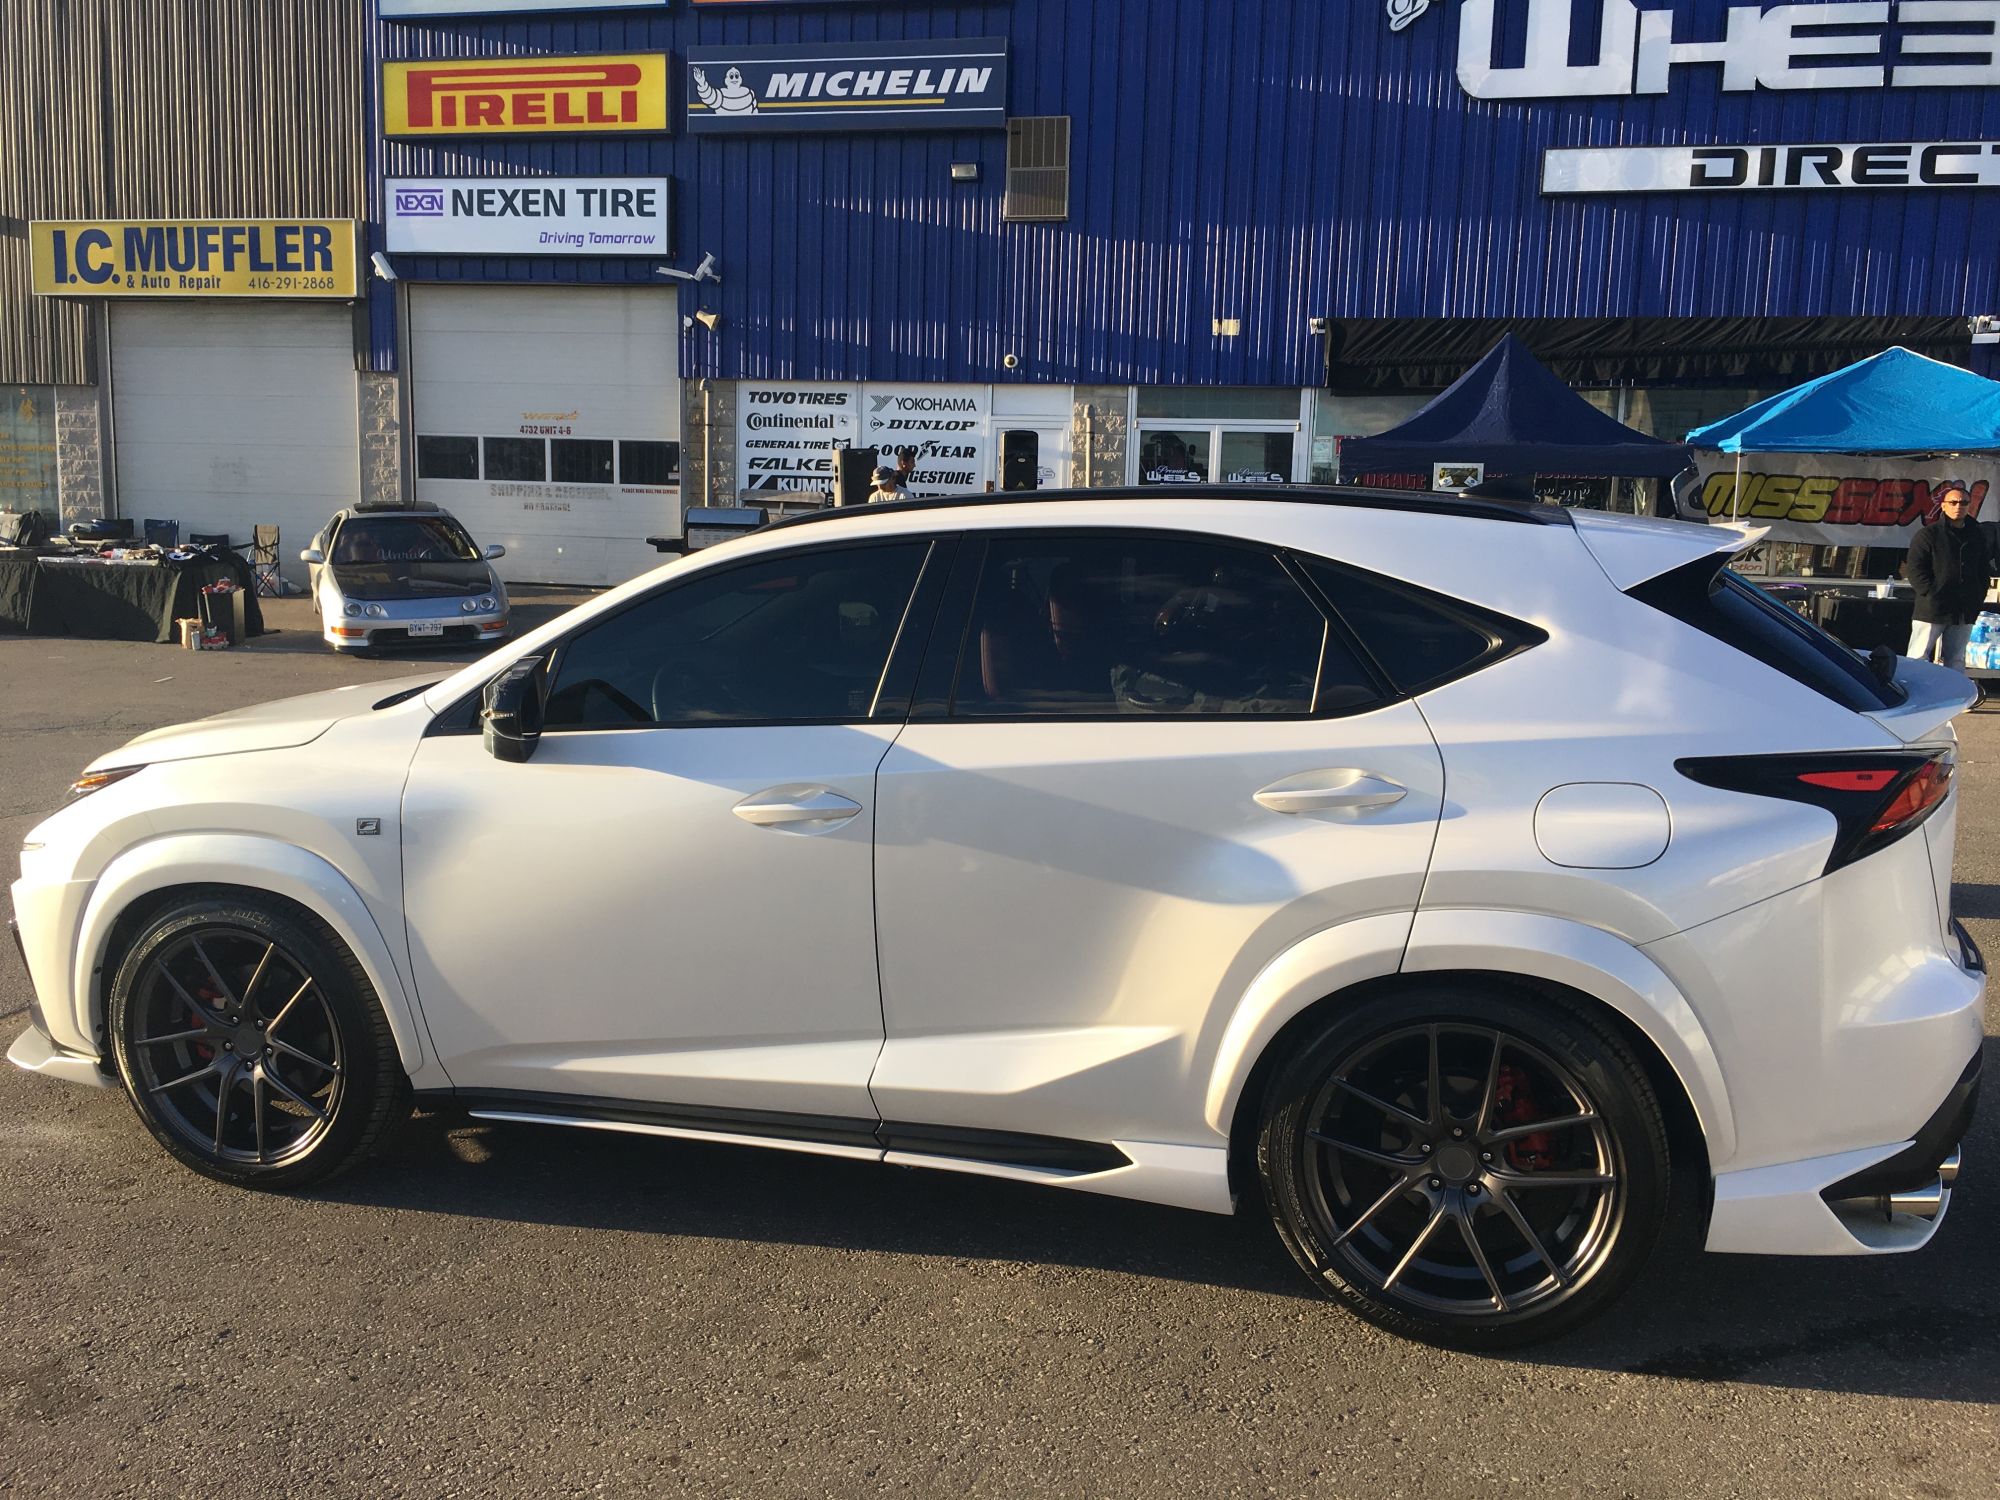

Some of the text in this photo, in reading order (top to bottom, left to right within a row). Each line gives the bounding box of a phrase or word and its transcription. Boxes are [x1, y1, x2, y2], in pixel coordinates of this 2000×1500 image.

[765, 67, 992, 98] MICHELIN
[407, 64, 641, 127] PIRELLI
[1690, 145, 2000, 187] DIREC
[452, 189, 656, 217] NEXEN TIRE
[539, 232, 655, 247] Driving Tomorrow
[52, 225, 333, 284] I.C. MUFFLER
[126, 275, 221, 290] & Auto Repair
[248, 277, 335, 290] 416-291-2868
[749, 391, 848, 405] TOYO TIRES
[895, 397, 976, 412] YOKOHAMA
[746, 412, 834, 430] Continental
[887, 419, 976, 431] DUNLOP
[540, 425, 557, 435] UNIT
[745, 440, 830, 450] GENERAL TIRE
[747, 457, 834, 471] FALKE
[908, 470, 976, 484] GESTONE
